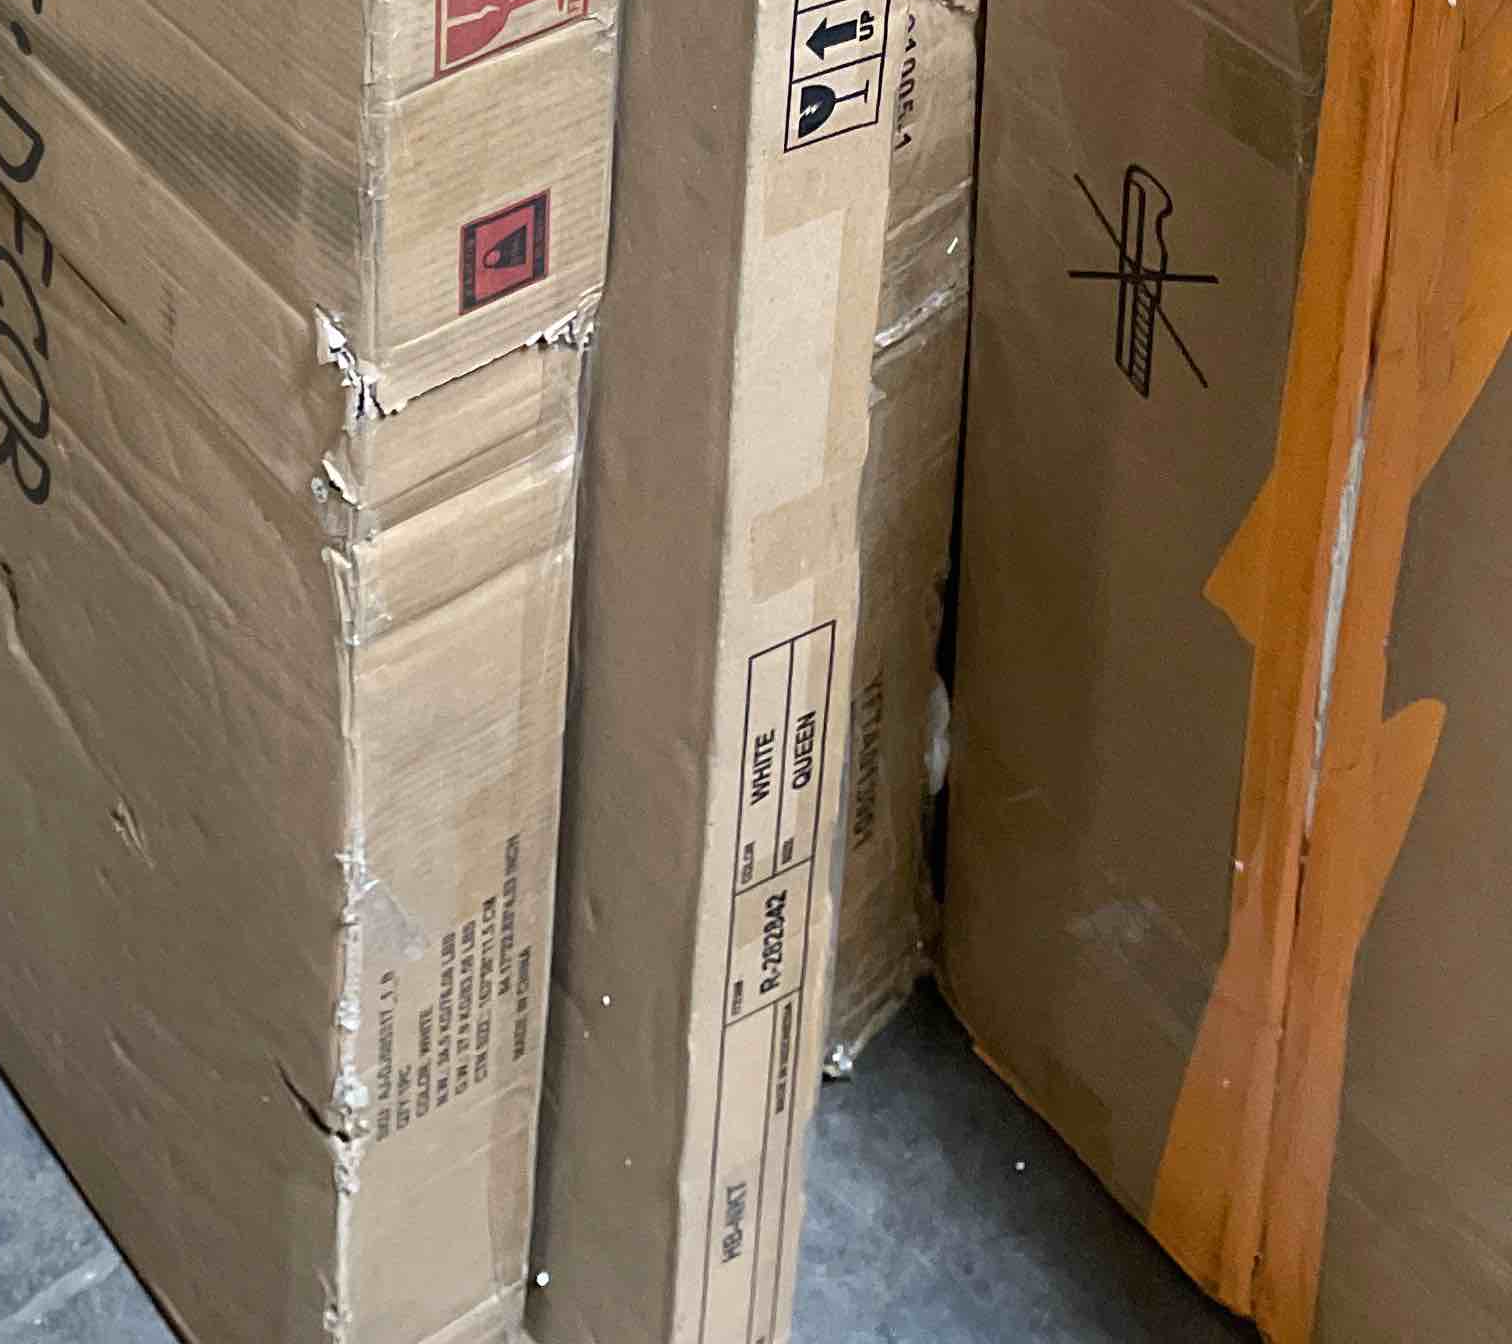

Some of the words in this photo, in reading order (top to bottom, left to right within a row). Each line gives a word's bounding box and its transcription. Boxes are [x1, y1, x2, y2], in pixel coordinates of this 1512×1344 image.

[859, 10, 875, 41] UP
[750, 727, 776, 806] WHITE
[792, 710, 816, 791] QUEEN
[419, 1004, 434, 1057] WHITE
